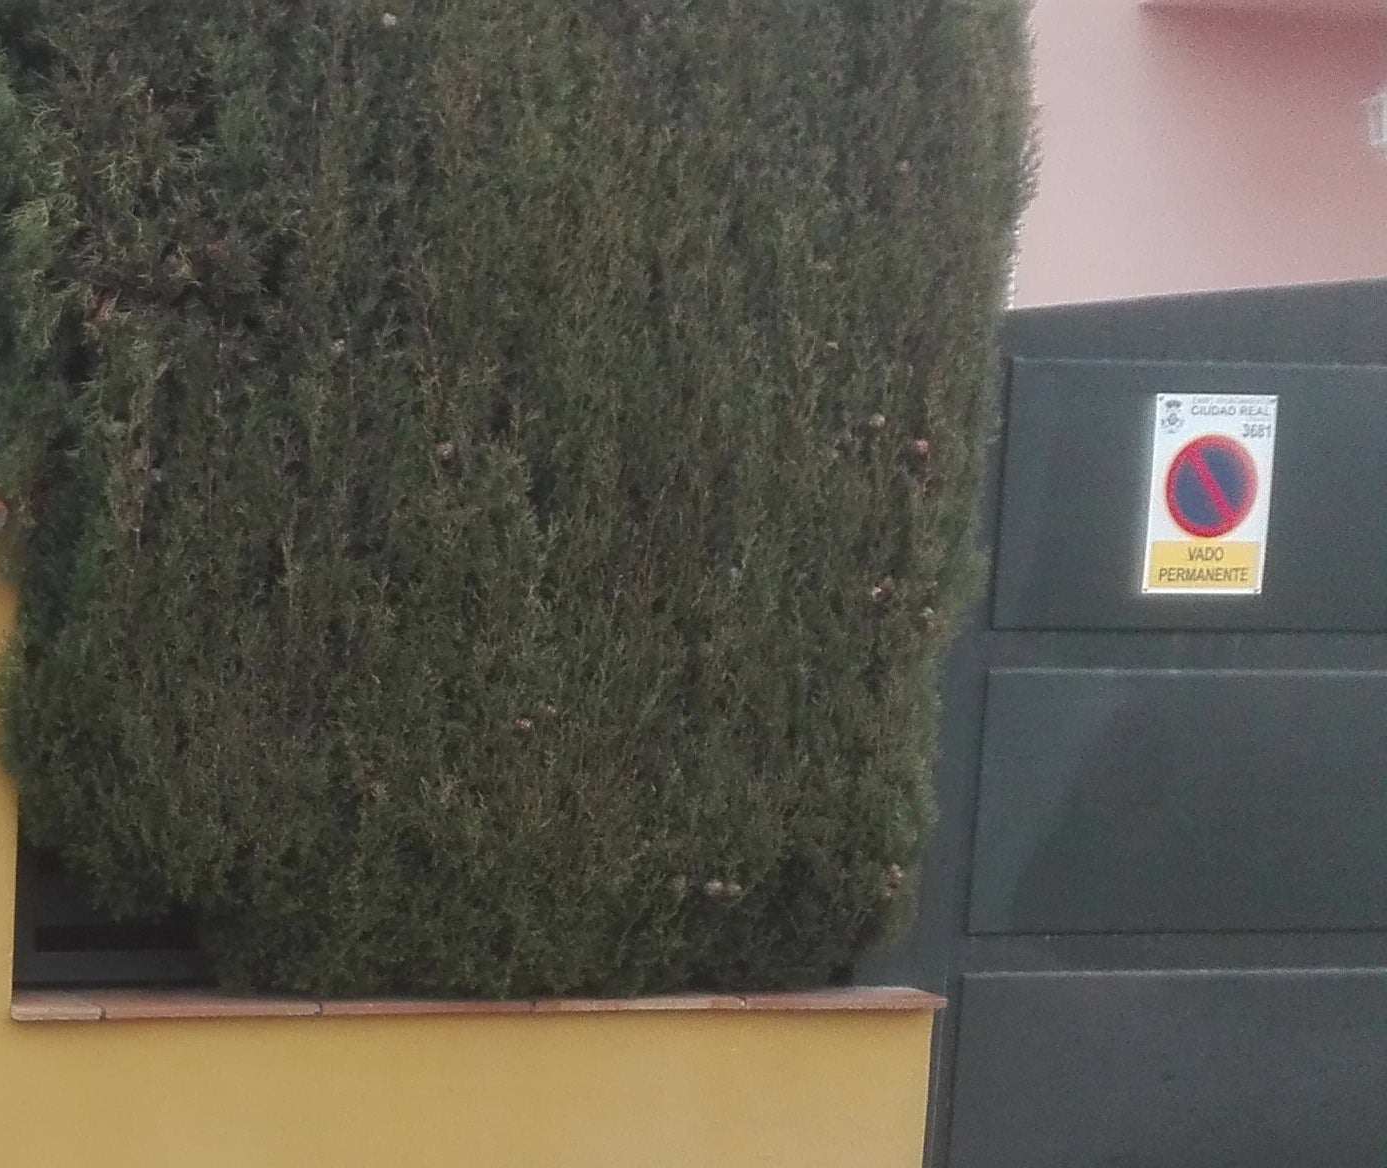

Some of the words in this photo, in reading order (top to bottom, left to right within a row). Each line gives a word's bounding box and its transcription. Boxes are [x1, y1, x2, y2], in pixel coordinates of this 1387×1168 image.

[1191, 405, 1237, 416] CIUDAD
[1240, 405, 1271, 416] REAL
[1187, 546, 1224, 561] VADO
[1159, 567, 1249, 582] PERMANENTE
